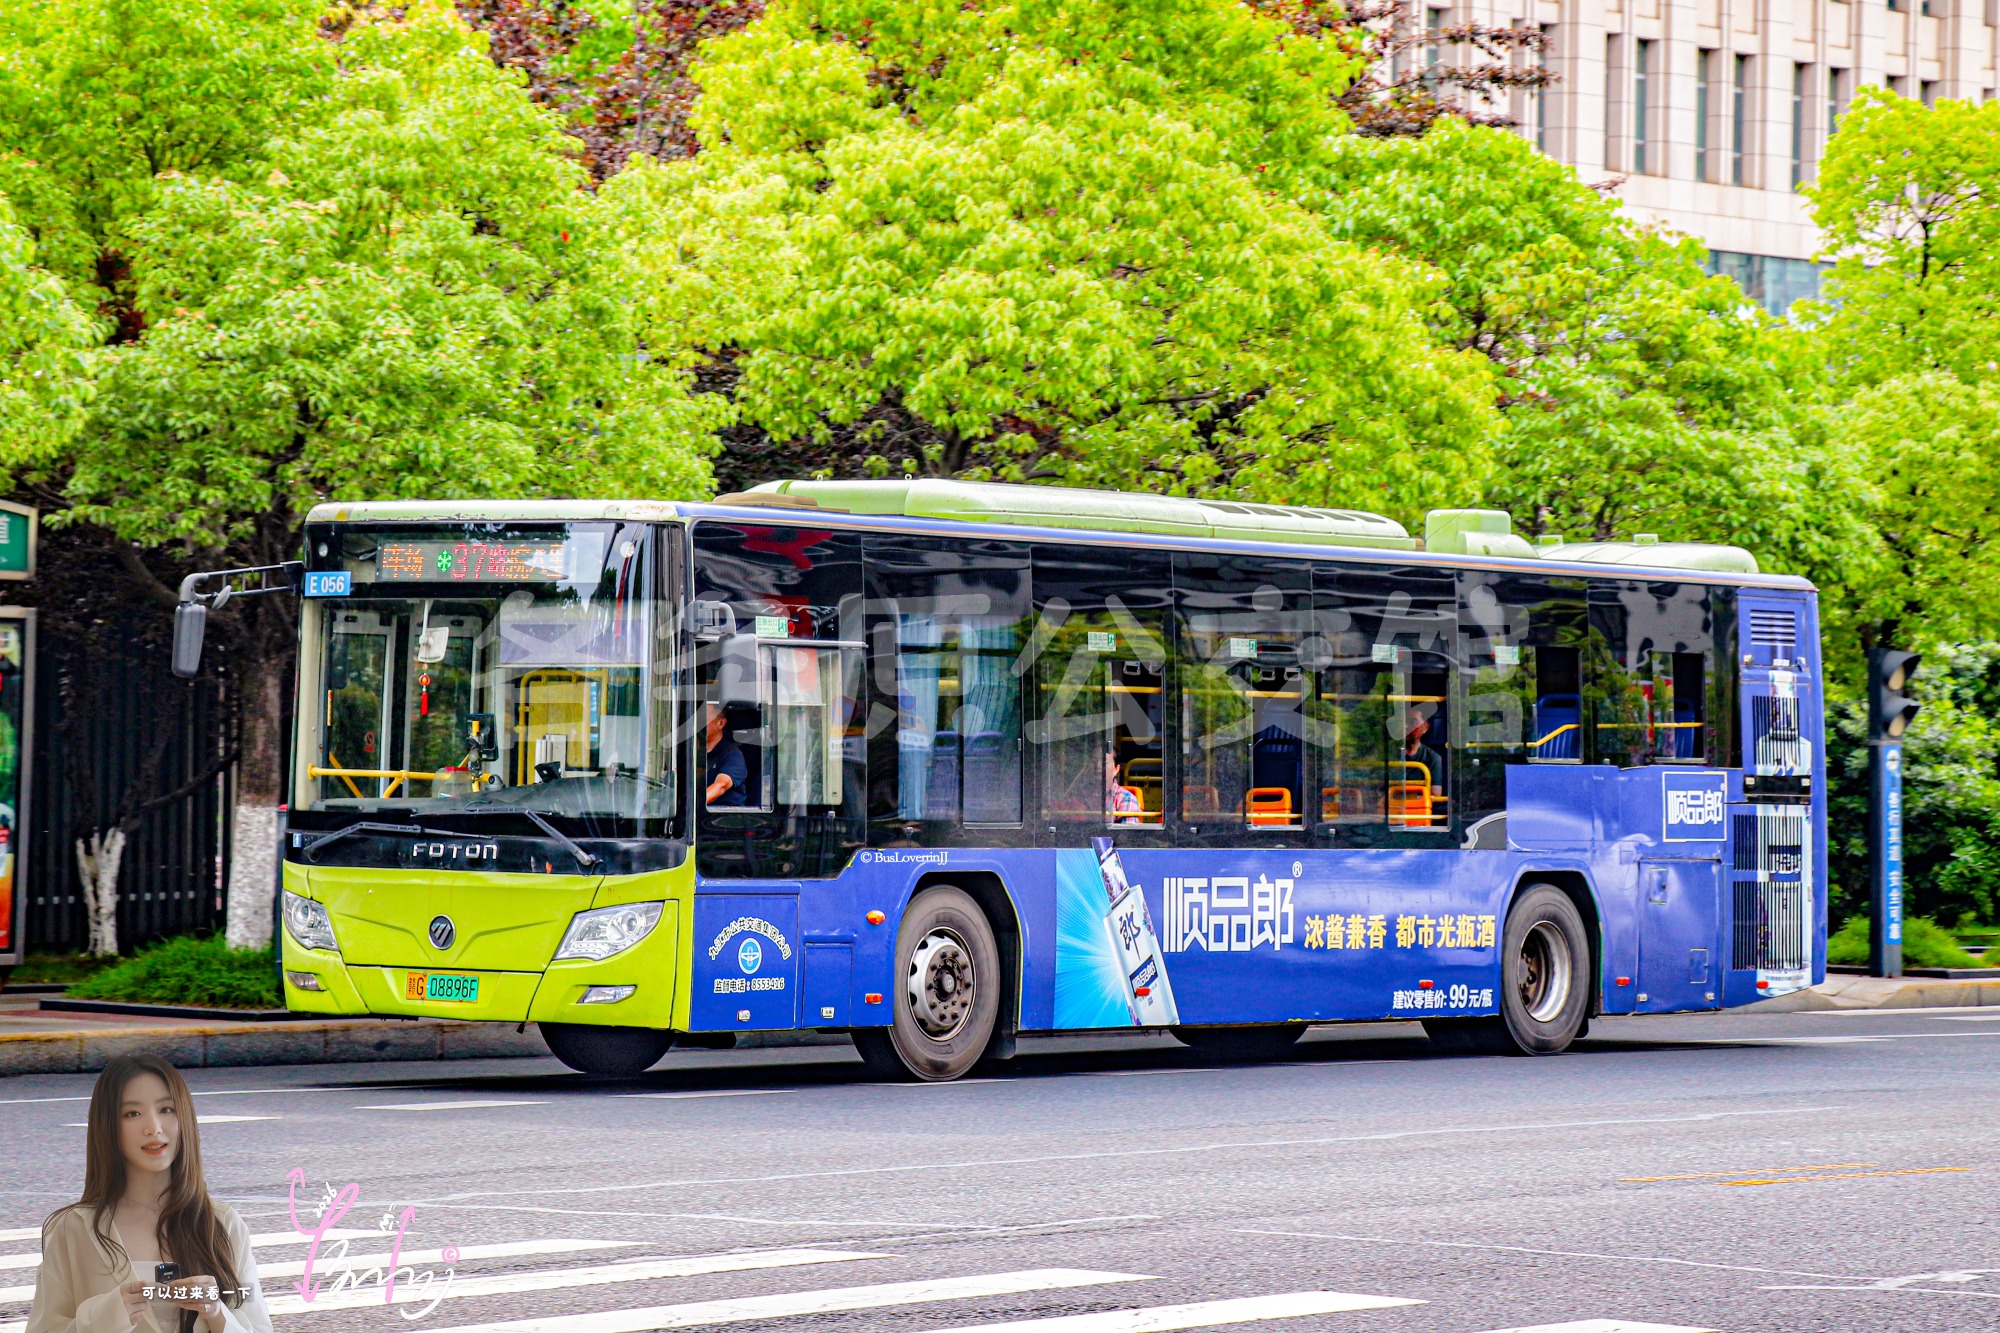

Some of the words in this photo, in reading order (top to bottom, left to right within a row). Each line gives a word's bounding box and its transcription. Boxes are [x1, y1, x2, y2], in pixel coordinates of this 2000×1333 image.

[310, 574, 318, 595] E
[321, 573, 345, 596] 056
[1668, 790, 1723, 825] 顺品郎
[412, 843, 498, 861] FOTON
[708, 917, 792, 960] 九江市公共交通集团公司
[1304, 914, 1387, 950] 浓酱兼香
[1396, 914, 1496, 948] 都市光瓶酒
[430, 977, 477, 998] 08896F
